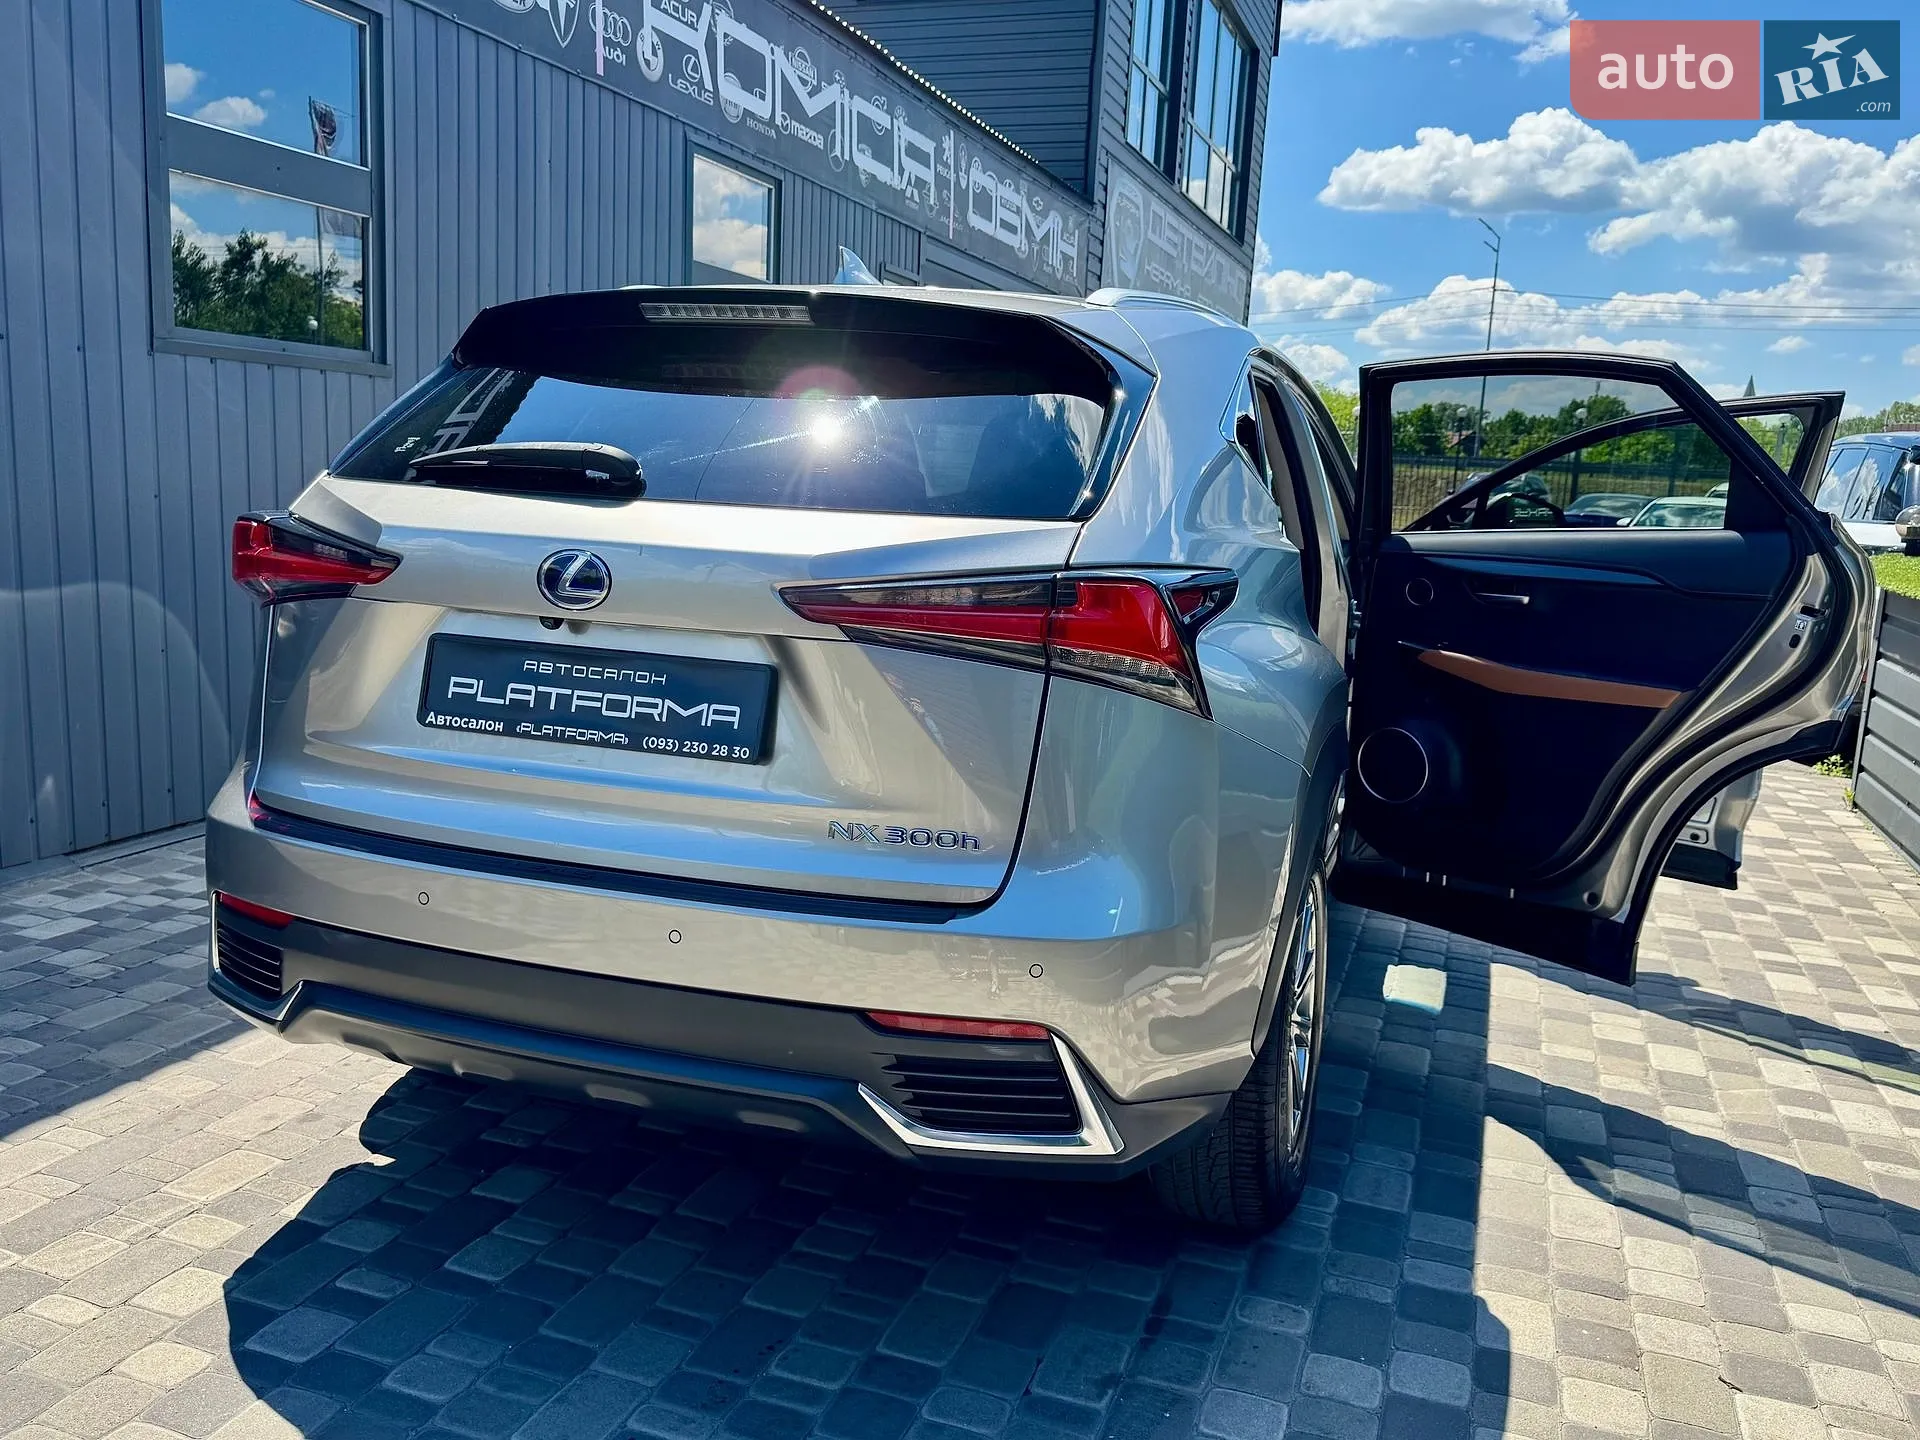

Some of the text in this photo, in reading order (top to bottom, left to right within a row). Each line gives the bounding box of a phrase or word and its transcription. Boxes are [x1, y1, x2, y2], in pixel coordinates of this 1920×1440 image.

[661, 0, 699, 28] ACUR
[668, 73, 714, 106] LEXUS
[746, 117, 777, 139] HONDA
[523, 660, 667, 686] АВТОСАЛОН
[447, 676, 741, 730] PLATFORMA
[425, 711, 504, 733] Автосалон
[642, 736, 750, 759] (093) 230 28 30
